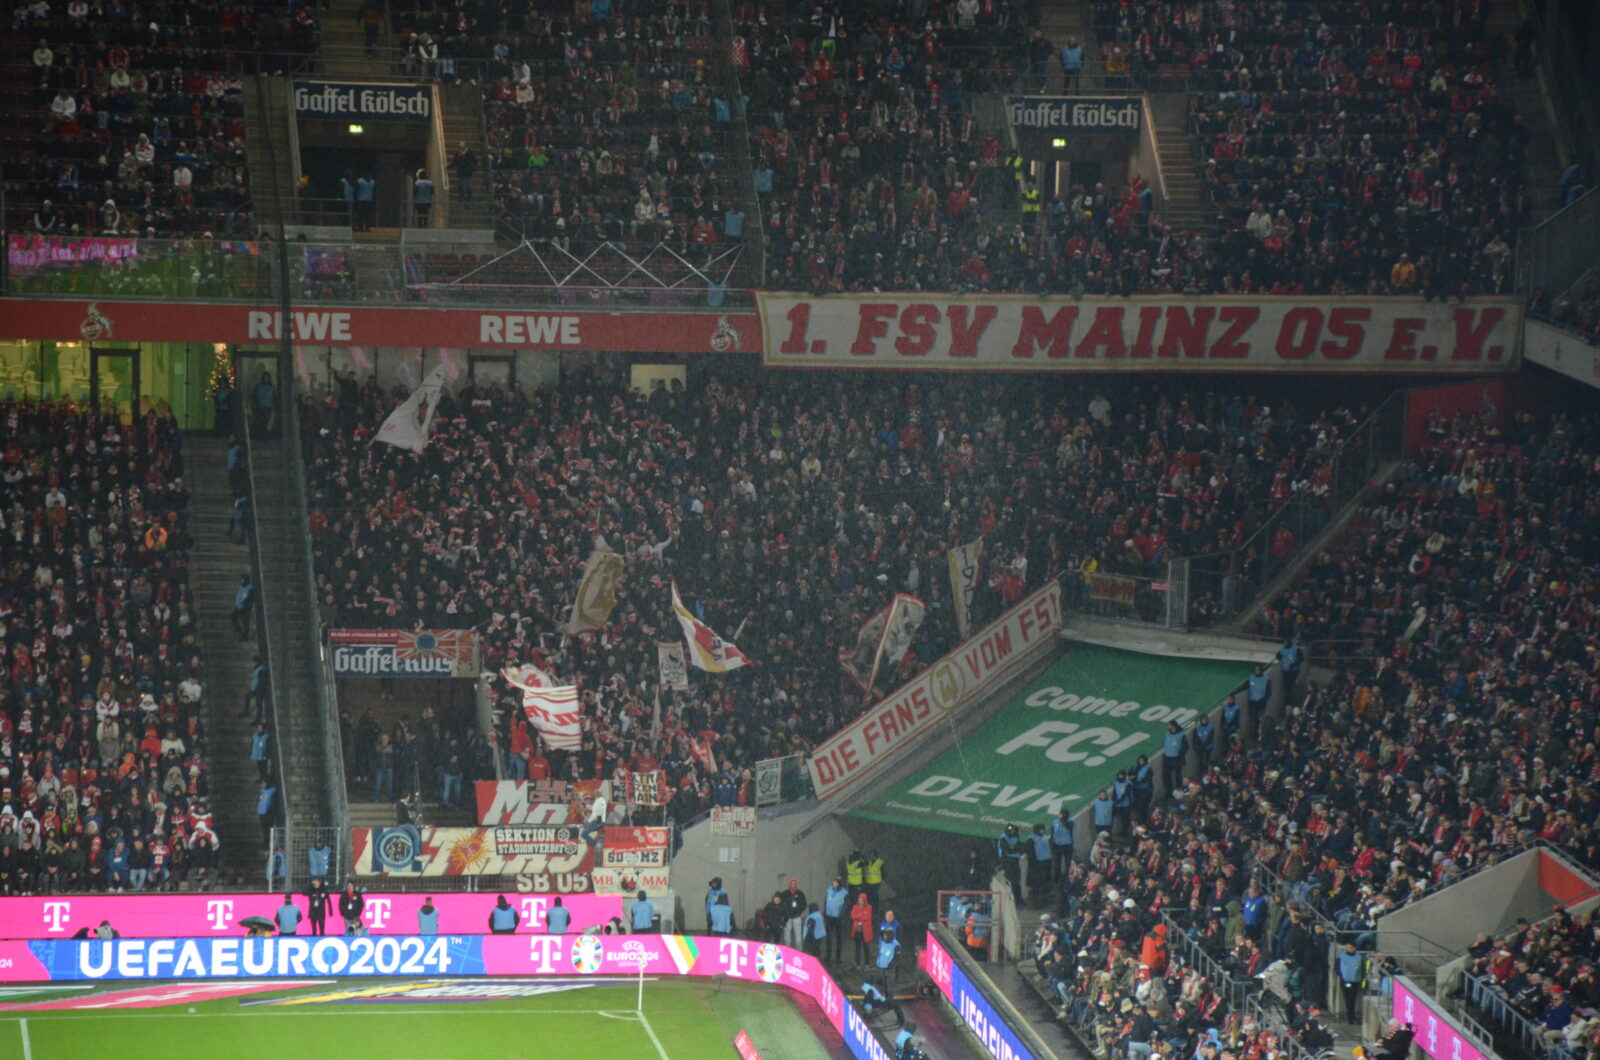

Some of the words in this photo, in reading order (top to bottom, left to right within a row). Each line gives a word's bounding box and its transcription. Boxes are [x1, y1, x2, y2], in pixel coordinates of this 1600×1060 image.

[295, 86, 357, 114] Gaffel
[360, 90, 429, 117] Kölsch
[1072, 103, 1139, 129] Kölsch
[249, 311, 352, 341] REWE
[480, 315, 581, 344] REWE
[780, 303, 827, 354] 1.
[850, 304, 998, 357] FSV
[1011, 305, 1260, 359] MAINZ
[1274, 308, 1371, 360] 05
[814, 738, 860, 786] DIE
[862, 687, 931, 755] FANS
[965, 625, 1013, 680] VOM
[1025, 686, 1140, 718] Come
[996, 721, 1150, 767] FC!
[907, 775, 1082, 815] DEVK
[496, 828, 556, 842] SEKTION
[517, 874, 550, 893] SB
[642, 876, 668, 886] MM
[43, 902, 70, 931] T
[207, 900, 233, 929] T
[365, 899, 391, 928] T
[522, 898, 547, 927] T
[531, 936, 561, 973] T
[720, 938, 747, 976] T
